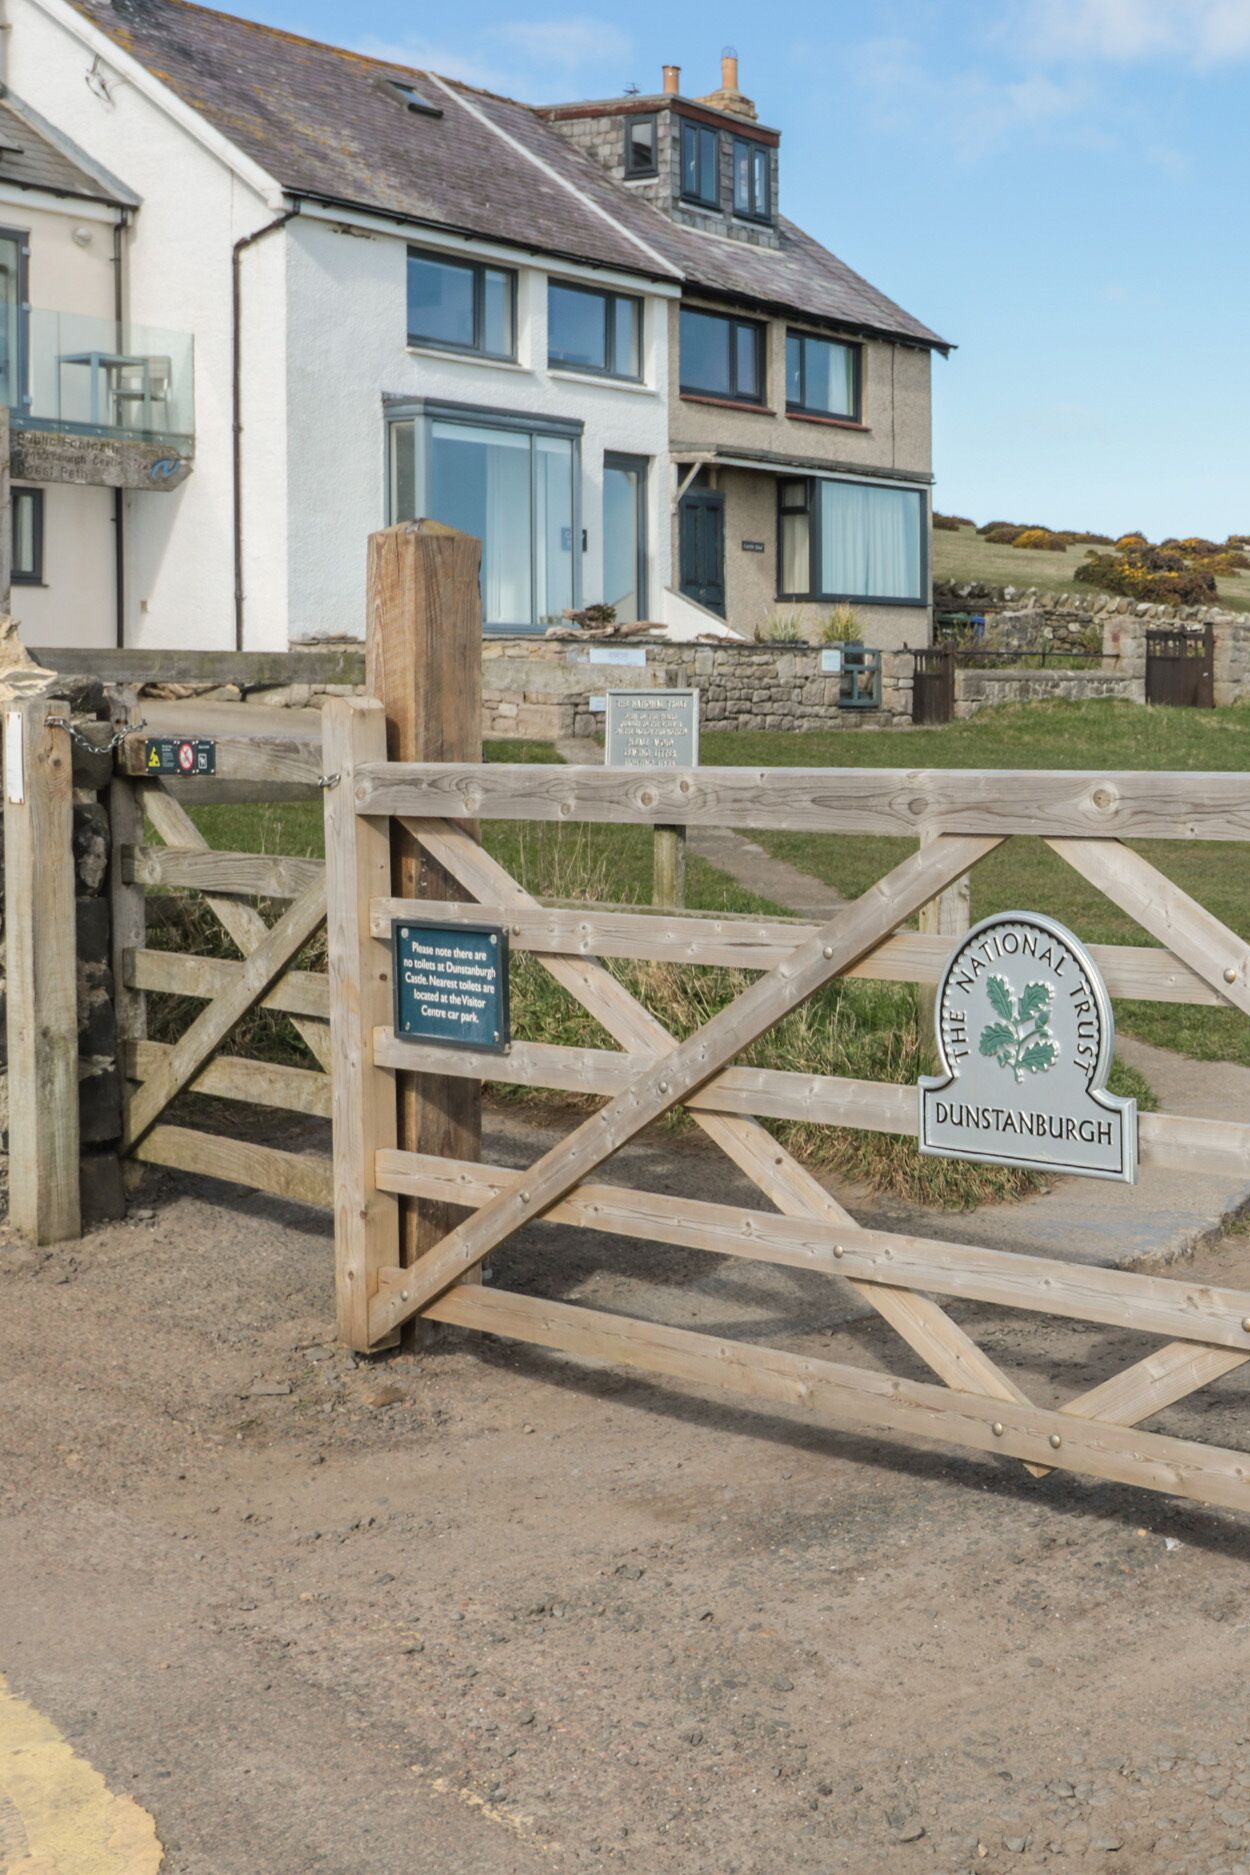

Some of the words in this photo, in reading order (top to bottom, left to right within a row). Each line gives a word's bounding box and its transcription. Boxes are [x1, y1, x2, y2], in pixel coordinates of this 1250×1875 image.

[412, 941, 434, 956] Please
[435, 947, 452, 957] note
[453, 947, 473, 960] there
[474, 951, 487, 961] are
[403, 959, 413, 968] no
[414, 959, 436, 971] toilets
[437, 962, 445, 972] at
[446, 961, 496, 981] Dunstanburgh
[955, 932, 1070, 995] NATIONAL
[405, 972, 428, 986] Castle.
[429, 975, 458, 990] Nearest
[459, 979, 482, 993] toilets
[483, 984, 495, 994] are
[413, 989, 439, 1002] located
[440, 993, 448, 1003] at
[449, 994, 461, 1005] the
[461, 995, 487, 1008] Visitor
[421, 1005, 446, 1019] Centre
[448, 1009, 459, 1020] car
[460, 1010, 480, 1024] park.
[949, 1008, 970, 1065] THE
[1069, 980, 1095, 1078] TRUST
[936, 1101, 1114, 1146] DUNSTANBURGH
